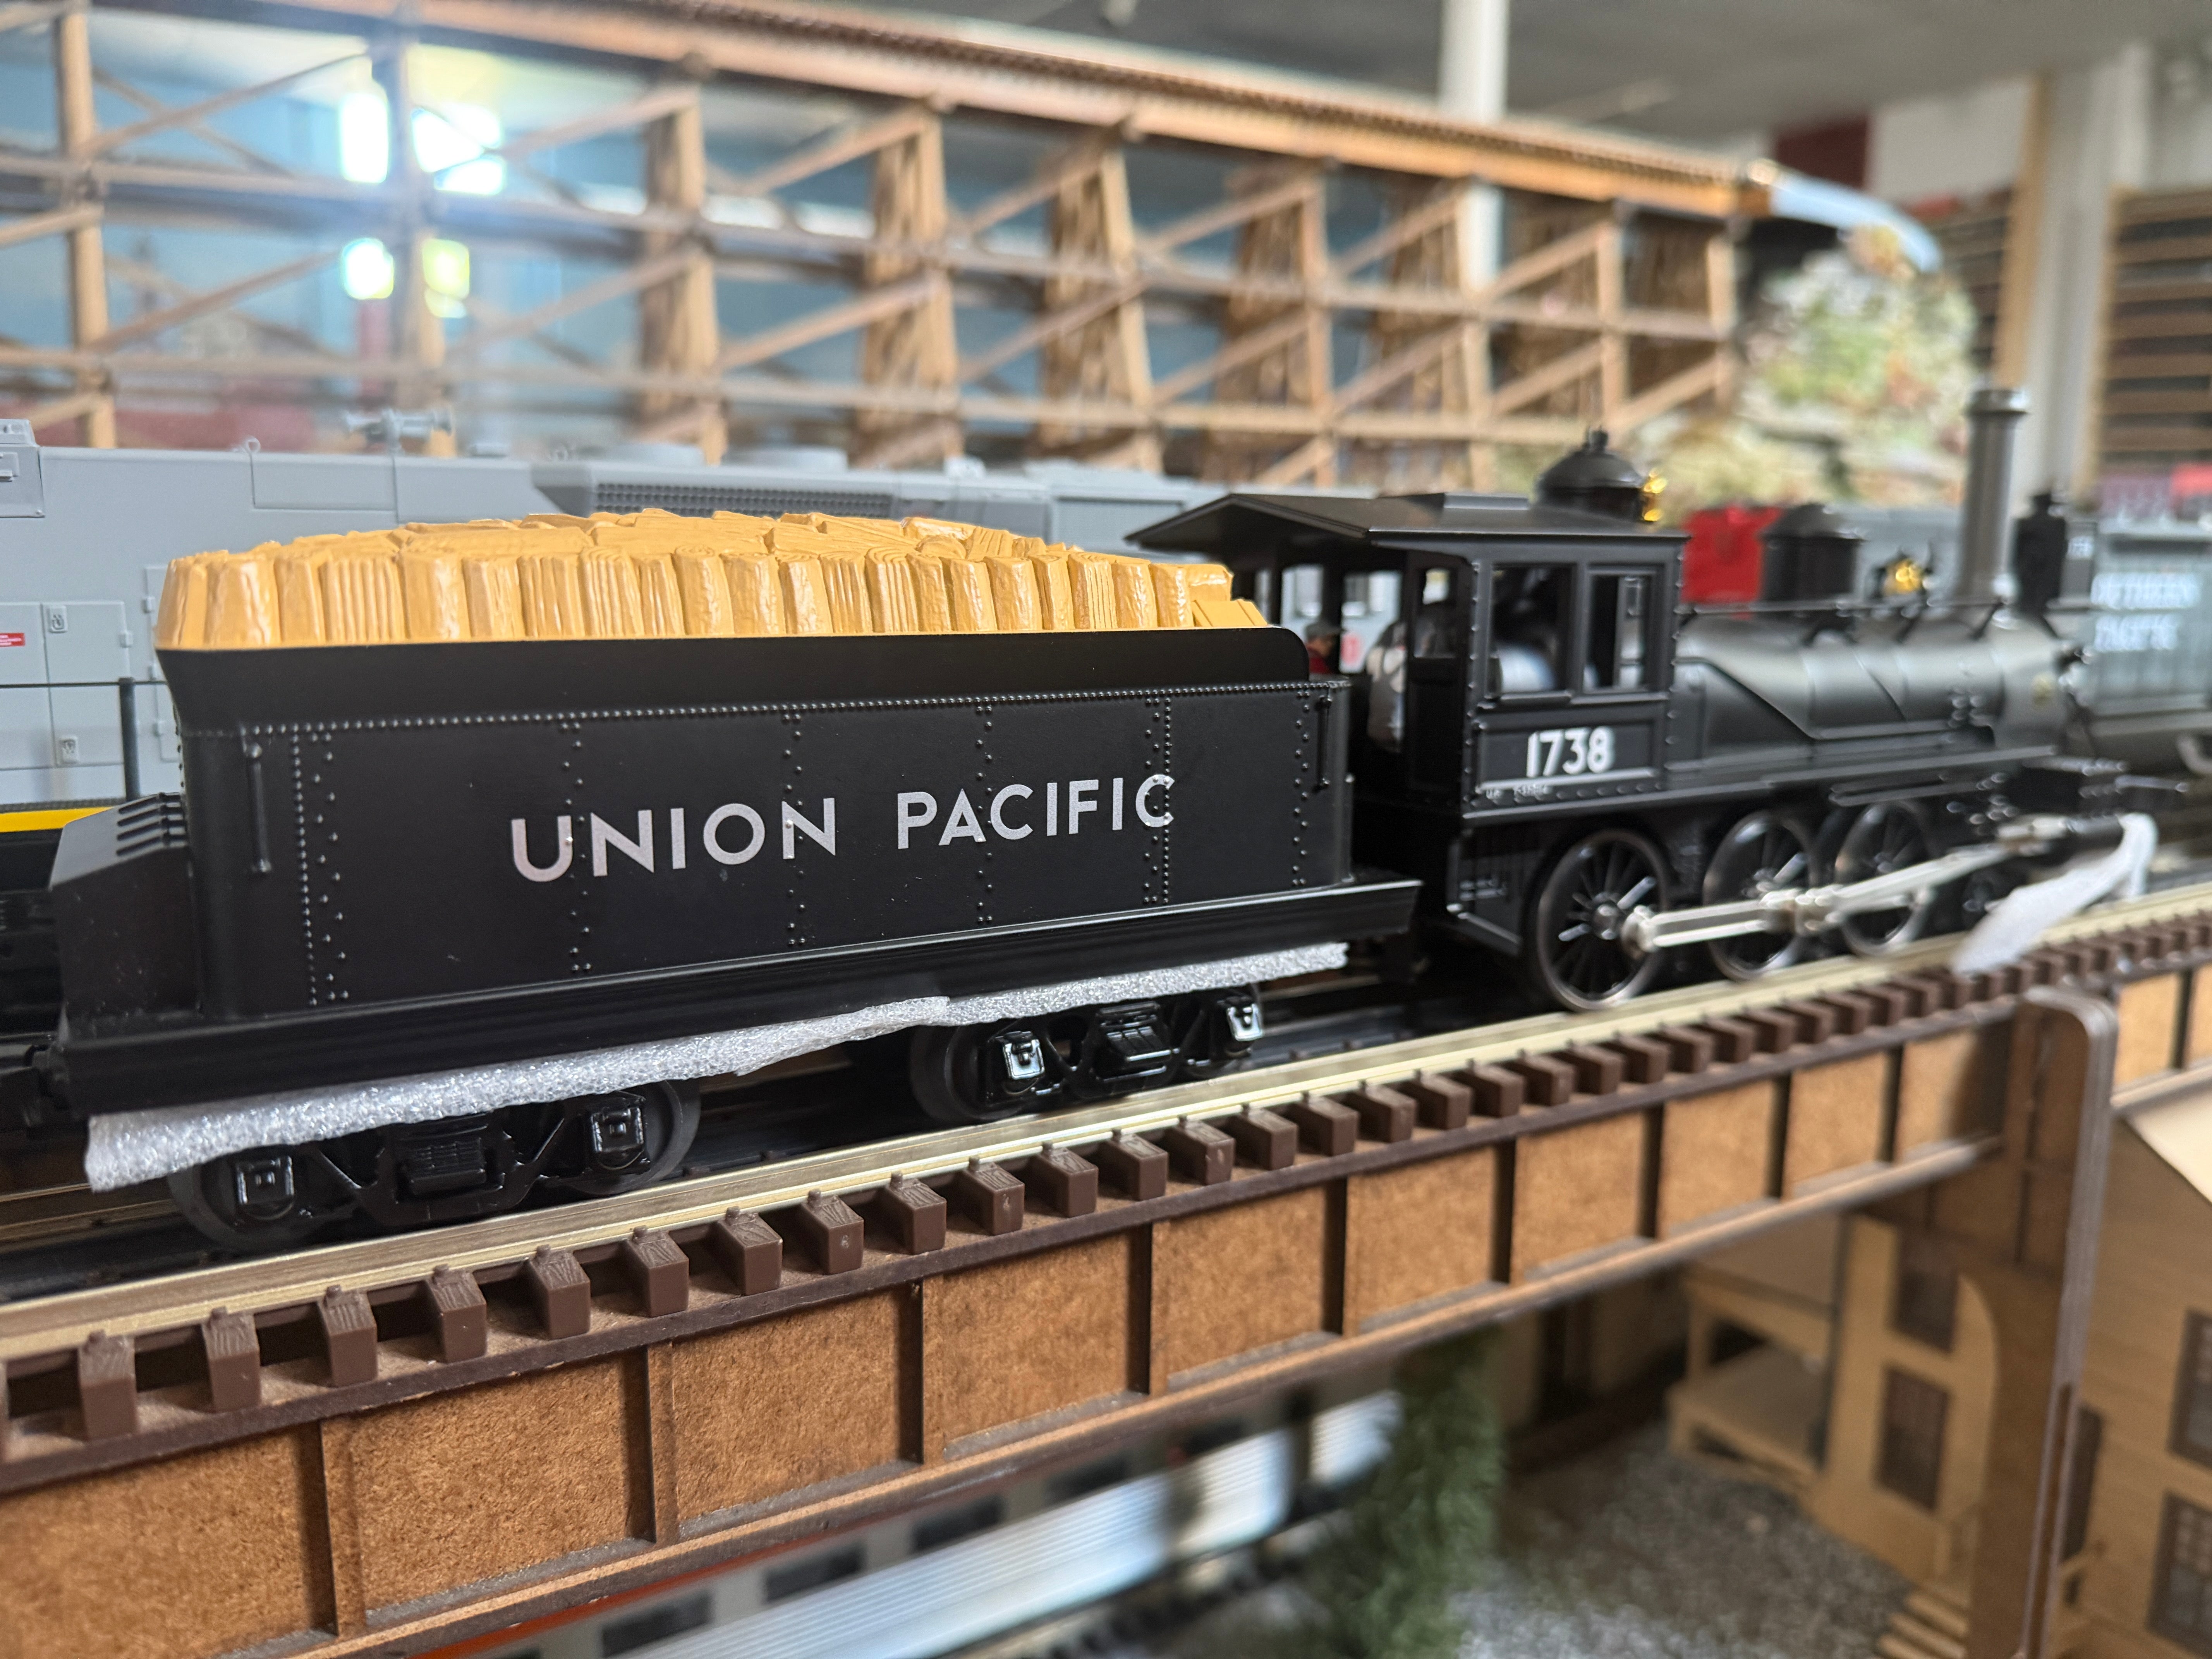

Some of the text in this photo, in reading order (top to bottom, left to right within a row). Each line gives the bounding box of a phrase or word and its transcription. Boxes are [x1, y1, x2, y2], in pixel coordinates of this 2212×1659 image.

[1527, 726, 1614, 778] 1738
[511, 774, 1175, 882] UNION PACIFIC
